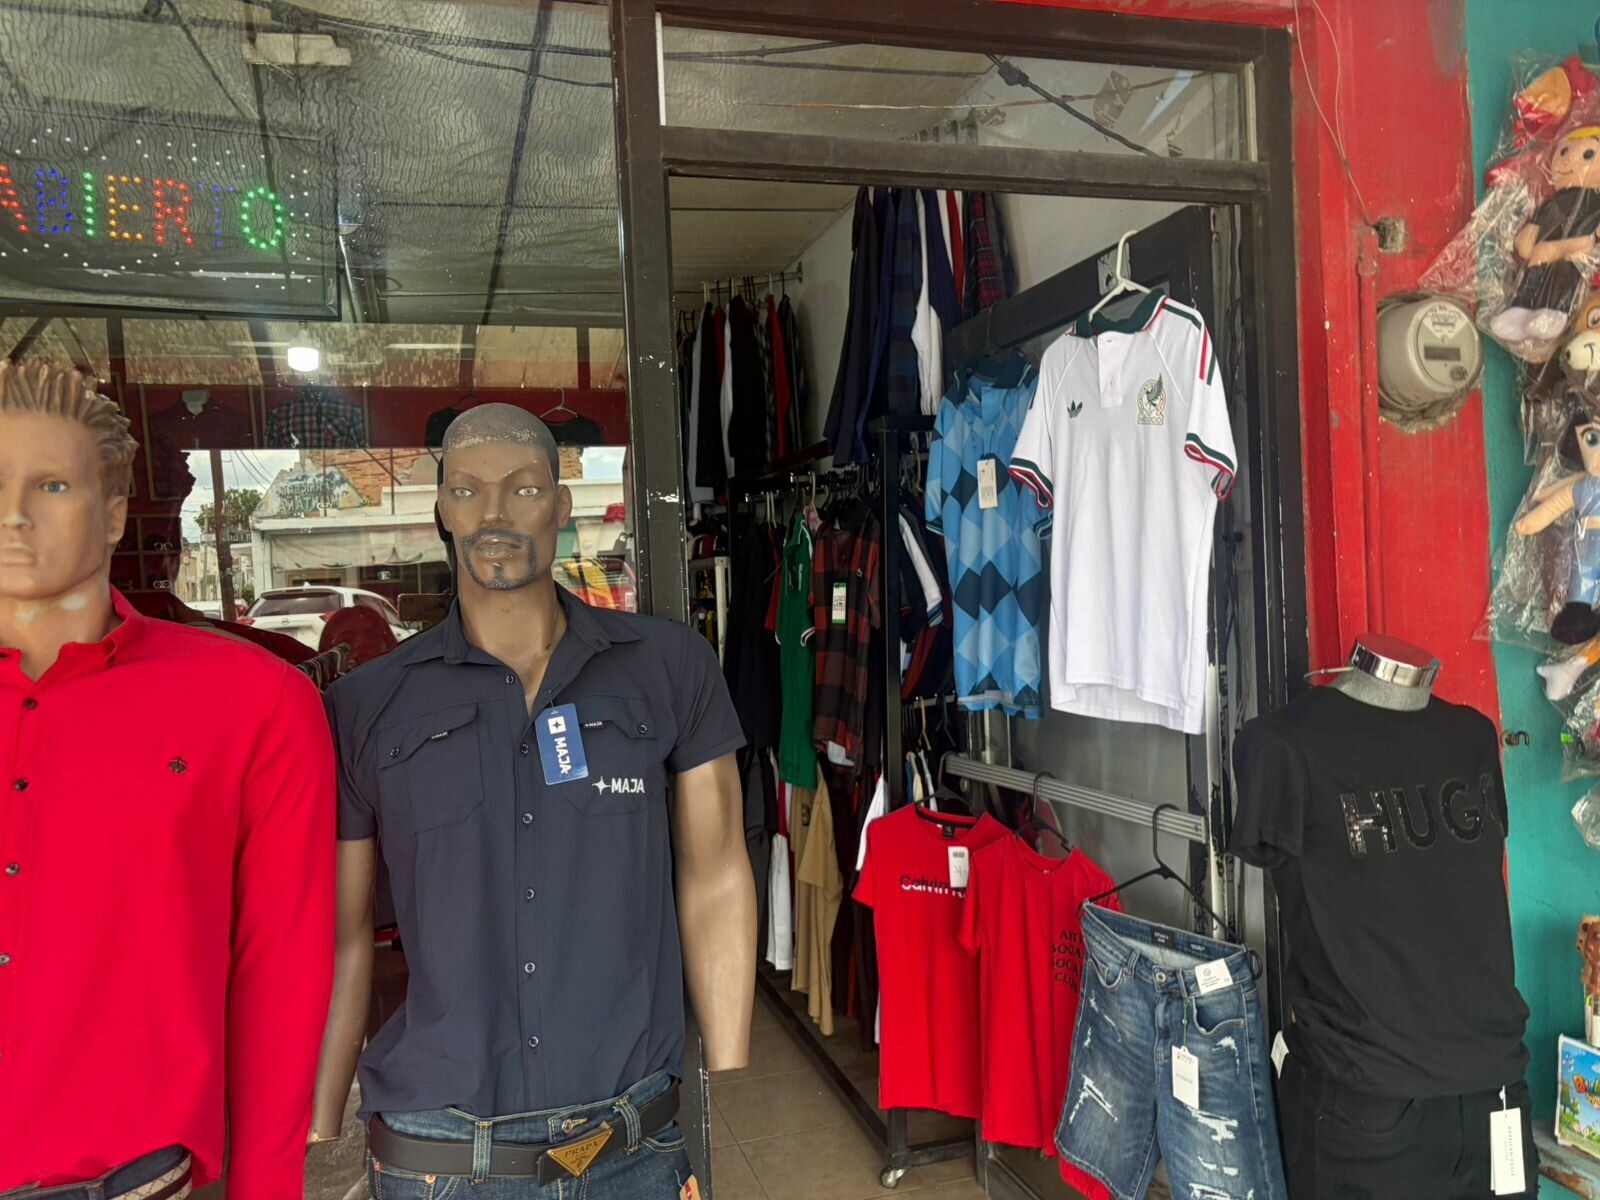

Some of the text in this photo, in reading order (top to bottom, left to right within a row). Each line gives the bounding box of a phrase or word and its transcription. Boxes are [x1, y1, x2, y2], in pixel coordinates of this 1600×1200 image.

[554, 736, 572, 775] MAJA
[611, 777, 646, 794] MAJA
[901, 874, 949, 896] Calvin
[564, 1140, 599, 1159] PRADA
